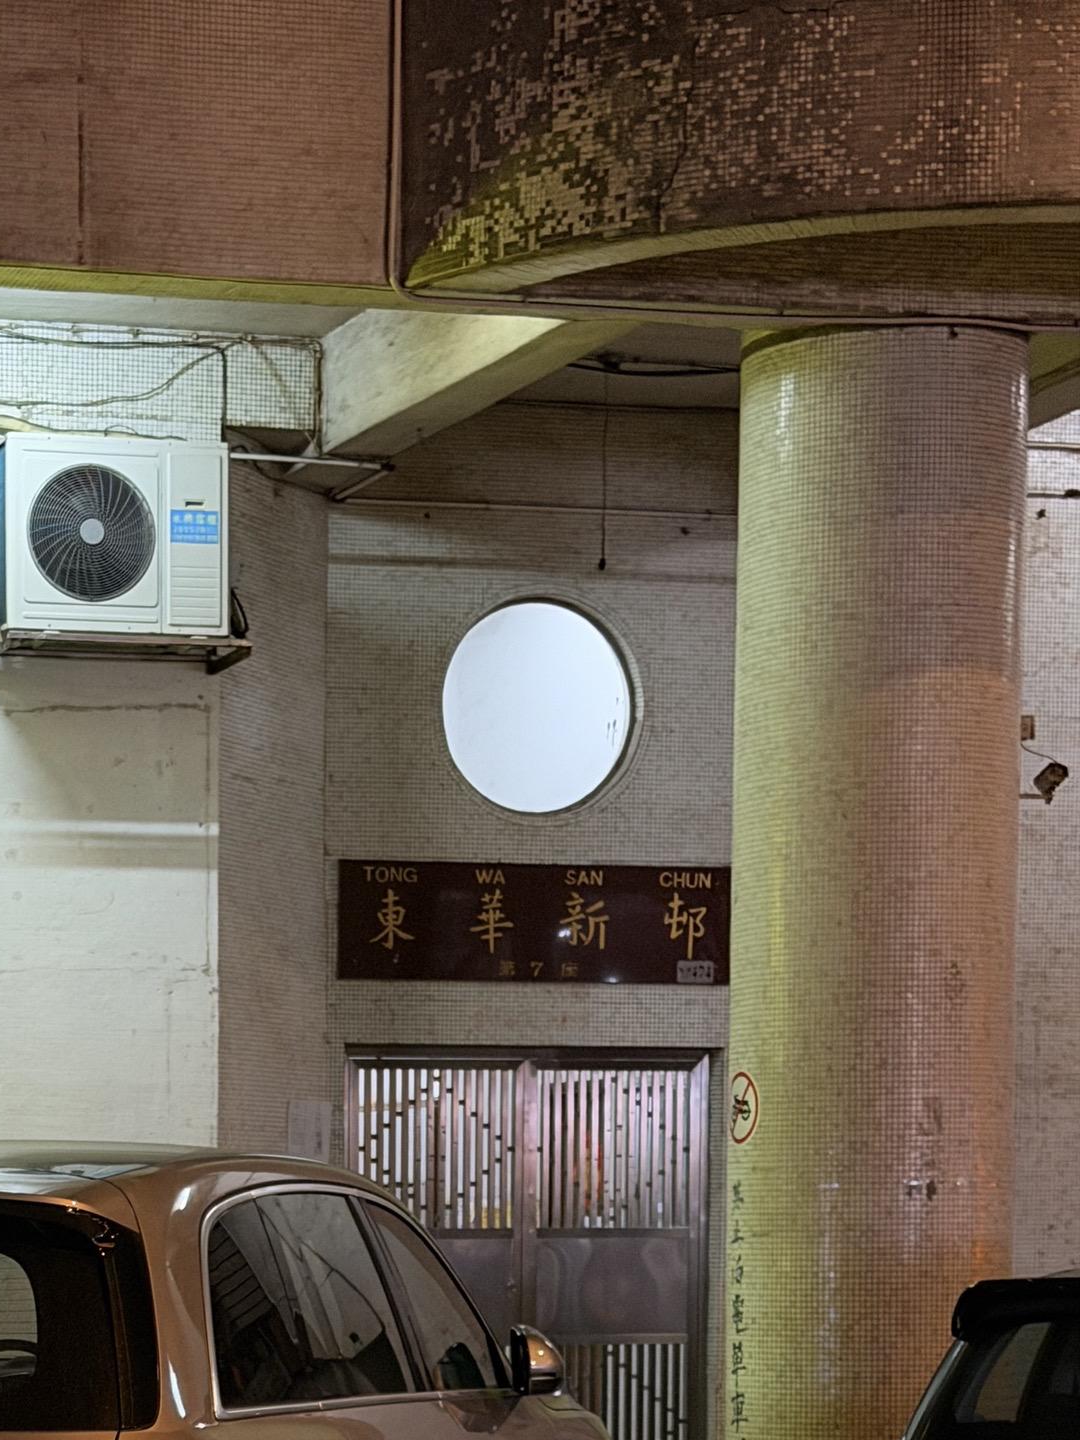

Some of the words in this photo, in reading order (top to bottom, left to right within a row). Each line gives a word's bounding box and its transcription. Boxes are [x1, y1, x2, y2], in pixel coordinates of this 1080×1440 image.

[363, 865, 418, 884] TONG
[475, 868, 506, 886] WA
[564, 869, 604, 888] SAN
[659, 871, 712, 890] CHUN
[369, 888, 708, 960] 東華新邨
